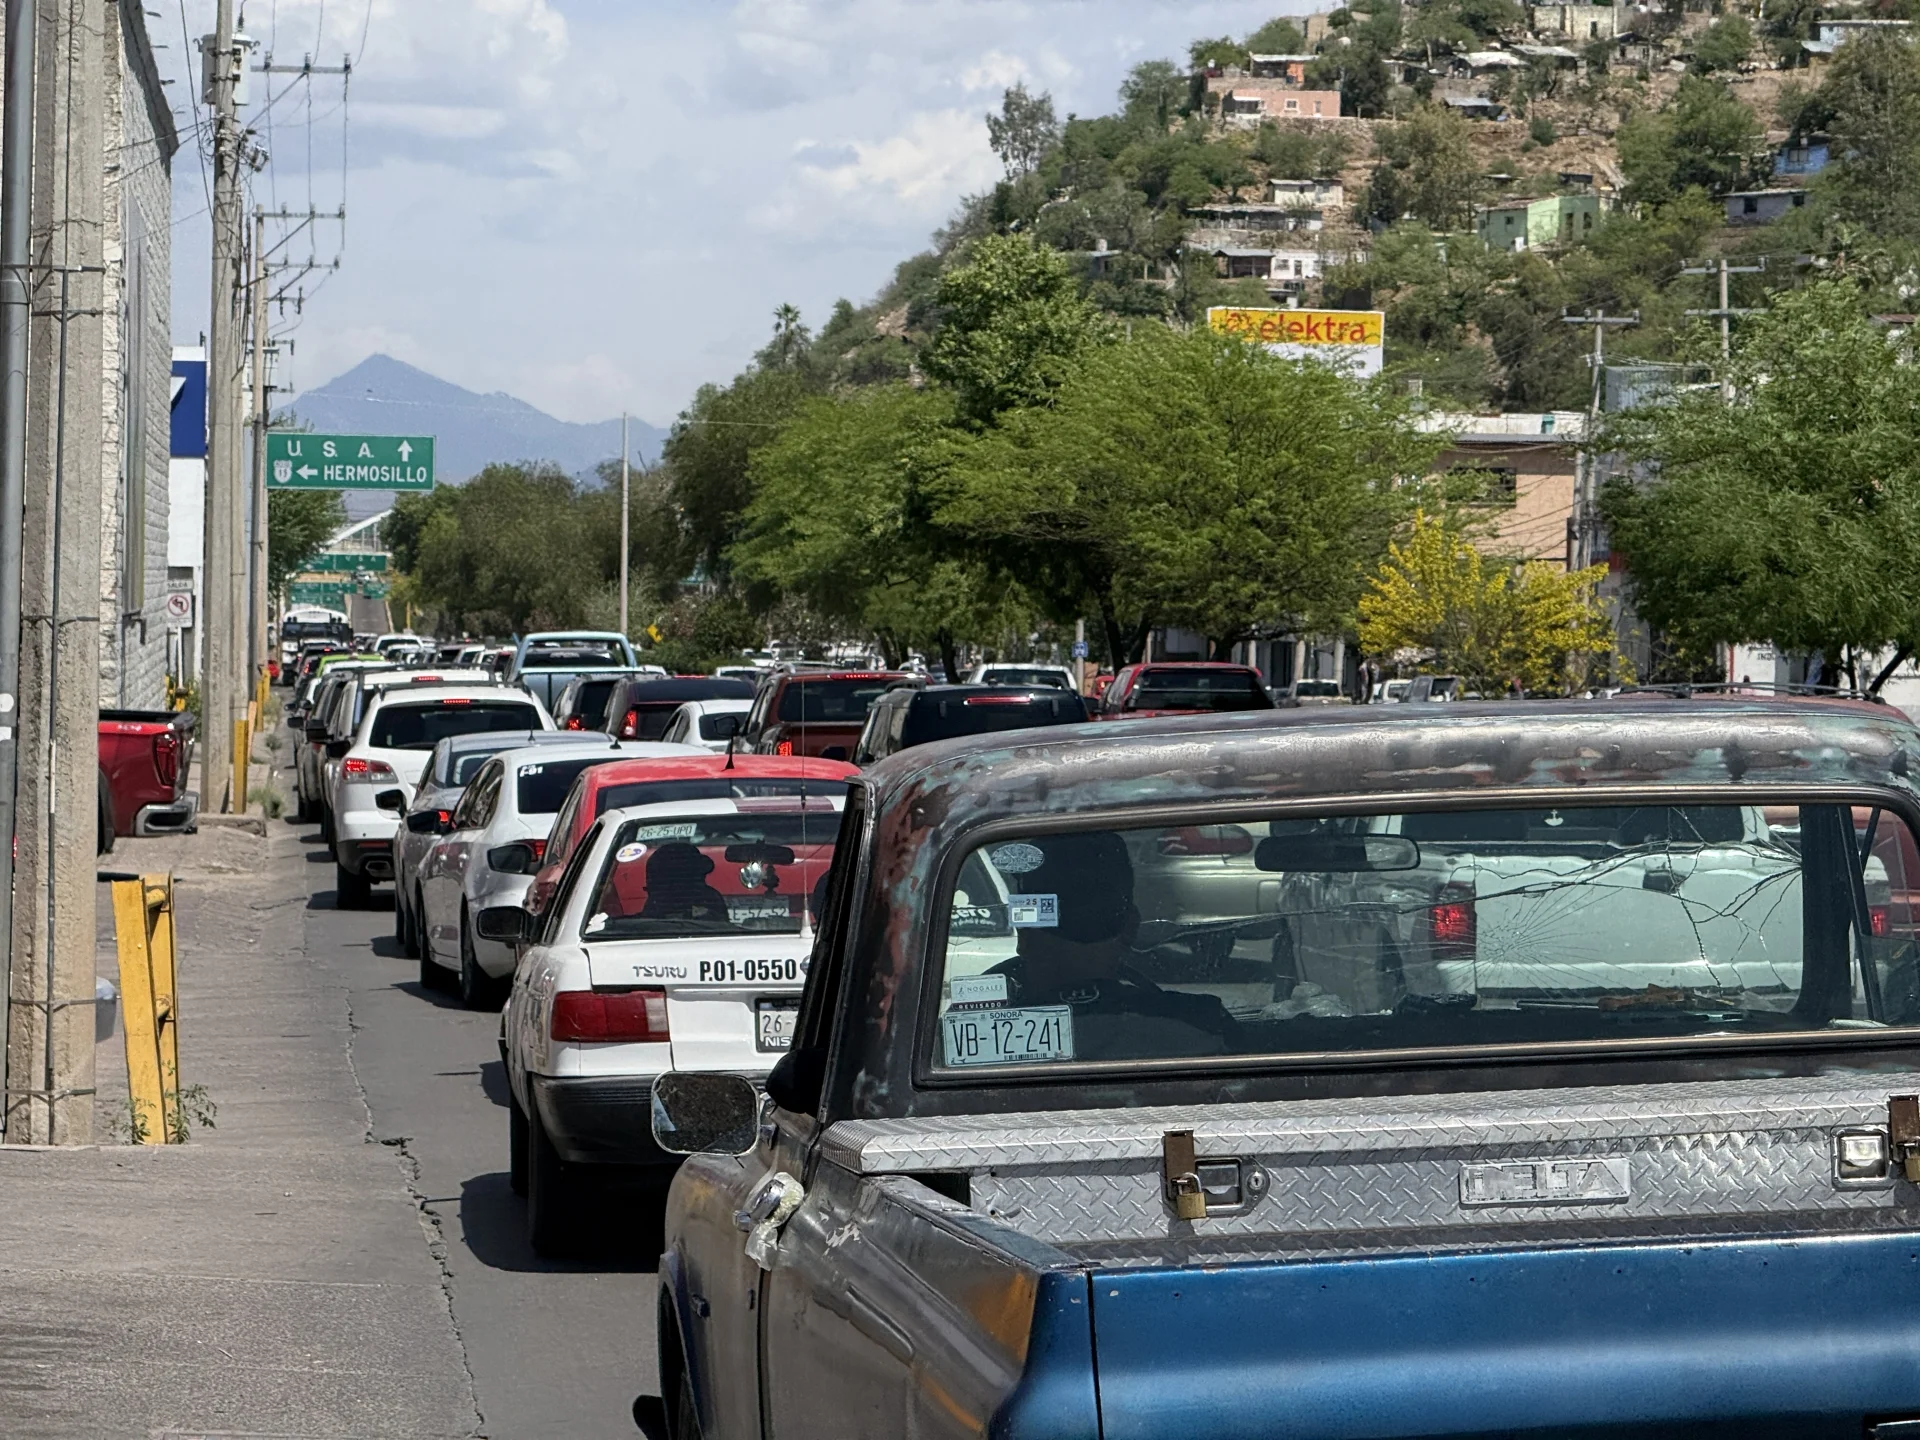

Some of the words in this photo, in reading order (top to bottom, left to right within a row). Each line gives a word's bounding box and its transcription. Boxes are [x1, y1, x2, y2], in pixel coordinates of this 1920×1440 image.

[1259, 314, 1366, 342] elektra
[323, 465, 427, 483] HERMOSILLO
[632, 965, 688, 979] TSURU
[699, 959, 797, 982] P.01-0550
[966, 984, 1003, 992] NOGALES
[958, 1001, 1002, 1010] REVISADO
[989, 1011, 1023, 1020] SONORA
[762, 1014, 797, 1034] 26-
[765, 1036, 792, 1047] NIS
[952, 1018, 1062, 1057] VB-12-241
